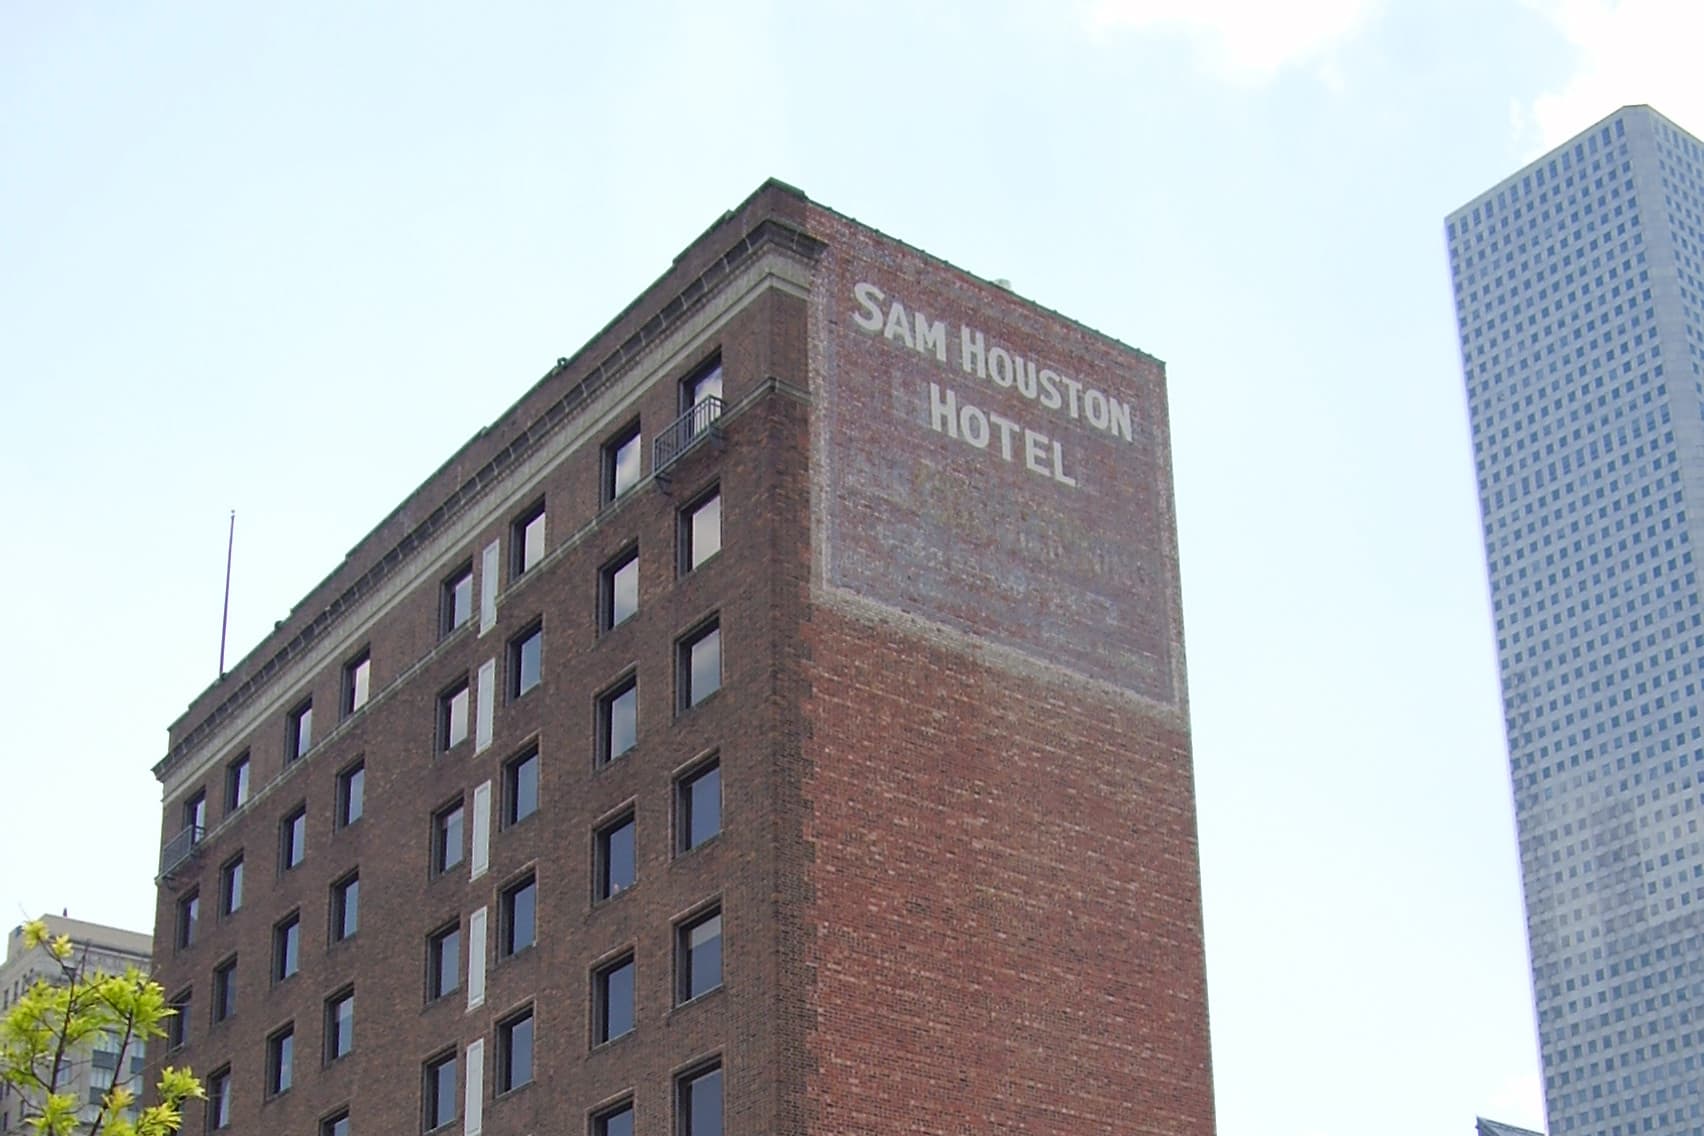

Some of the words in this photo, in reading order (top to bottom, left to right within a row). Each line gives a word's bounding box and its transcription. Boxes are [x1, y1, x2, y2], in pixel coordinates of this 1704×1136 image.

[852, 282, 947, 363] SAM
[960, 323, 1133, 442] HOUSTON
[929, 382, 1076, 487] HOTEL
